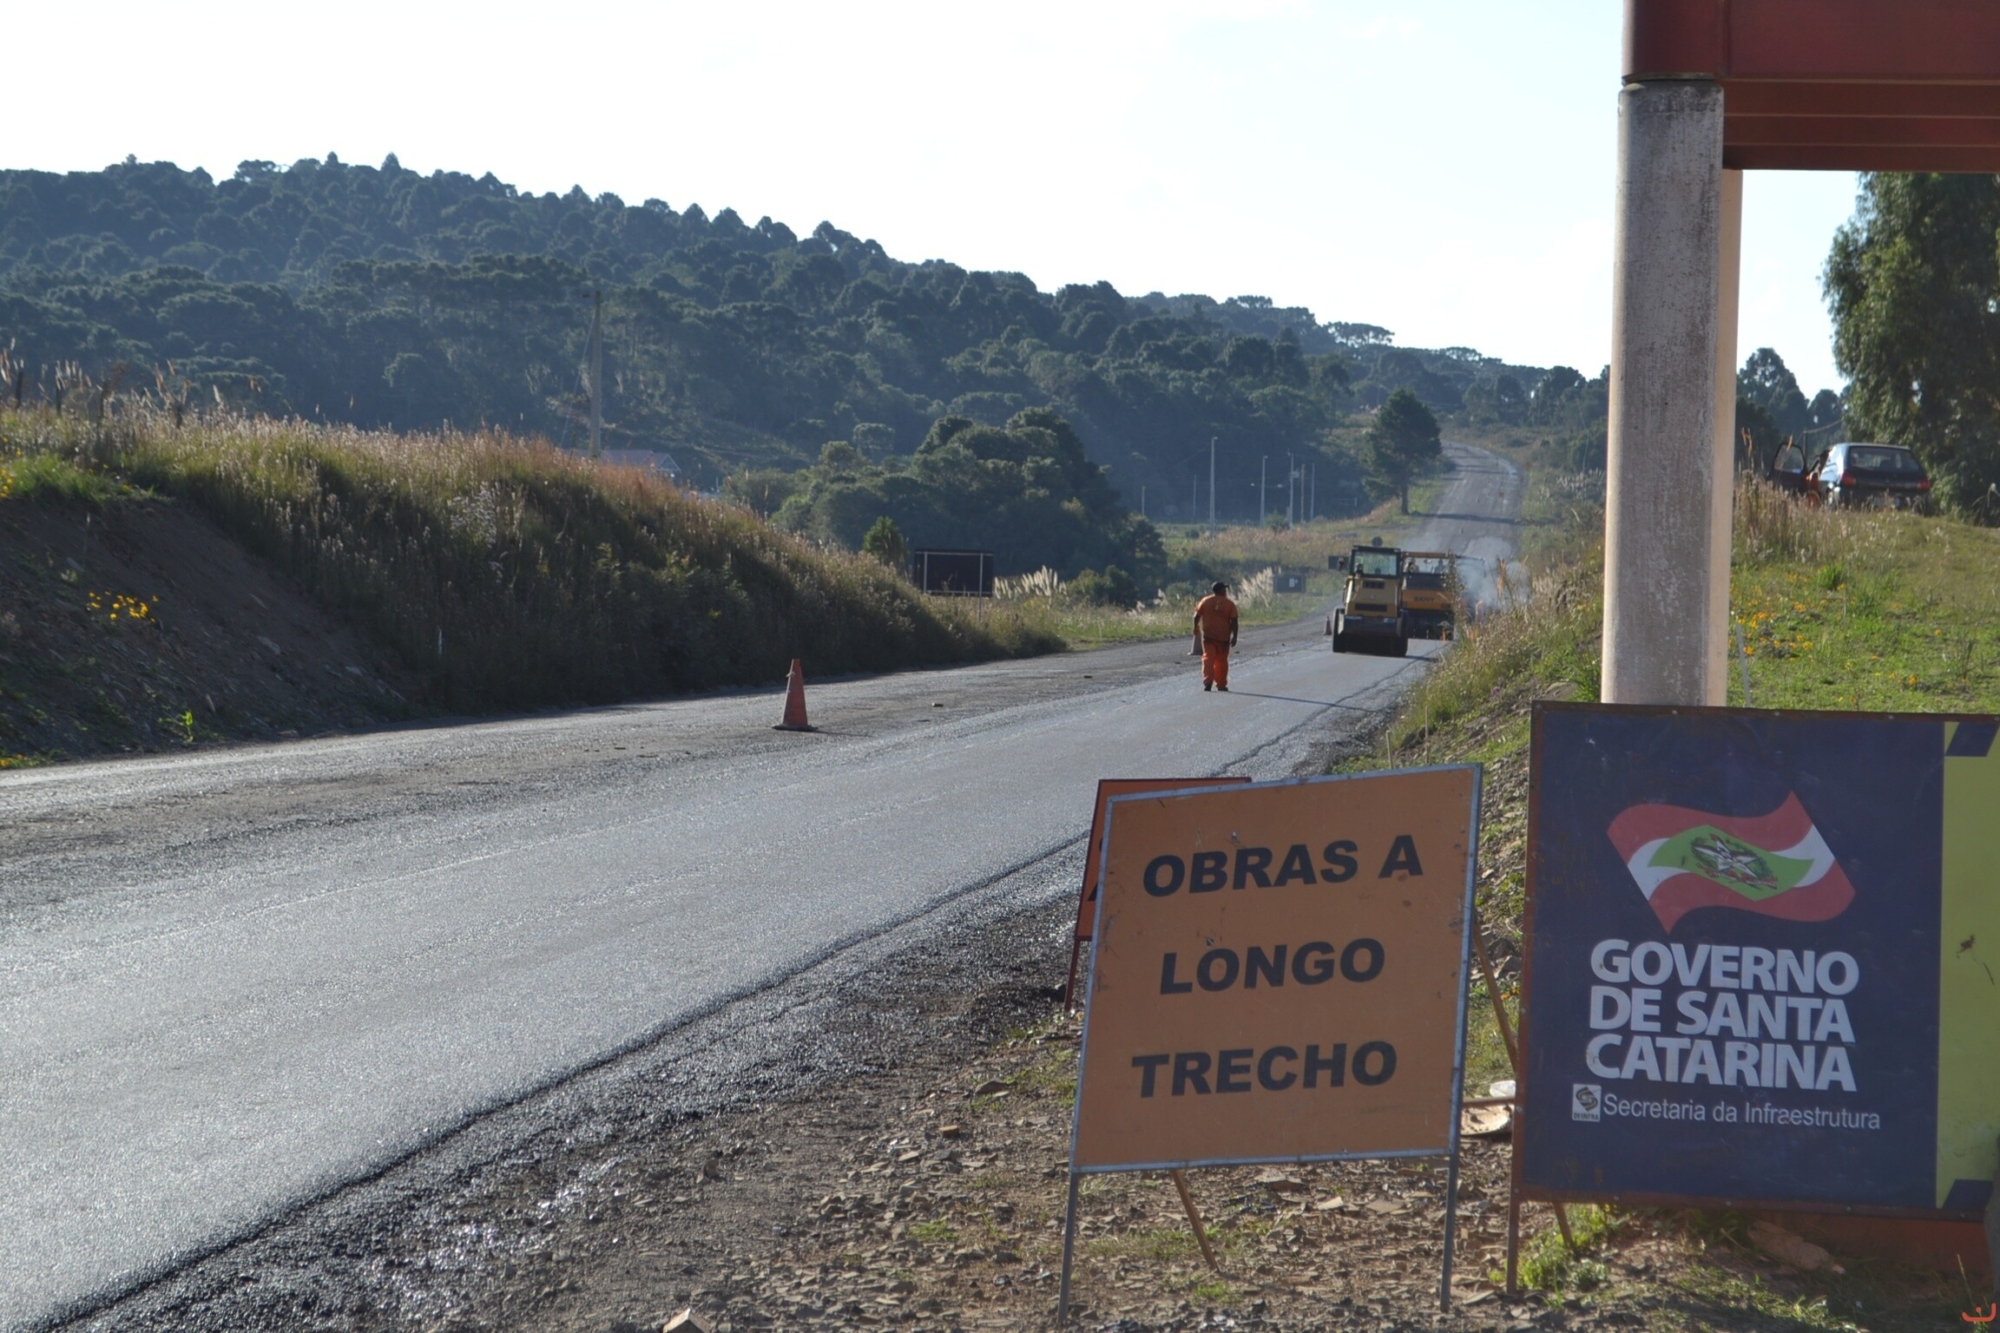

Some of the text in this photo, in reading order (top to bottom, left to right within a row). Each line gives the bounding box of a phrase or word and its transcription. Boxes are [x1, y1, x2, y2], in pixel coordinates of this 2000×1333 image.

[1143, 839, 1358, 897] OBRAS
[1379, 834, 1424, 879] A
[1160, 938, 1385, 994] LONGO
[1590, 939, 1860, 996] GOVERNO
[1589, 985, 1856, 1043] DE SANTA
[1131, 1041, 1397, 1098] TRECHO
[1585, 1033, 1857, 1092] CATARINA
[1603, 1093, 1881, 1130] Secretaria da Infraestrutura
